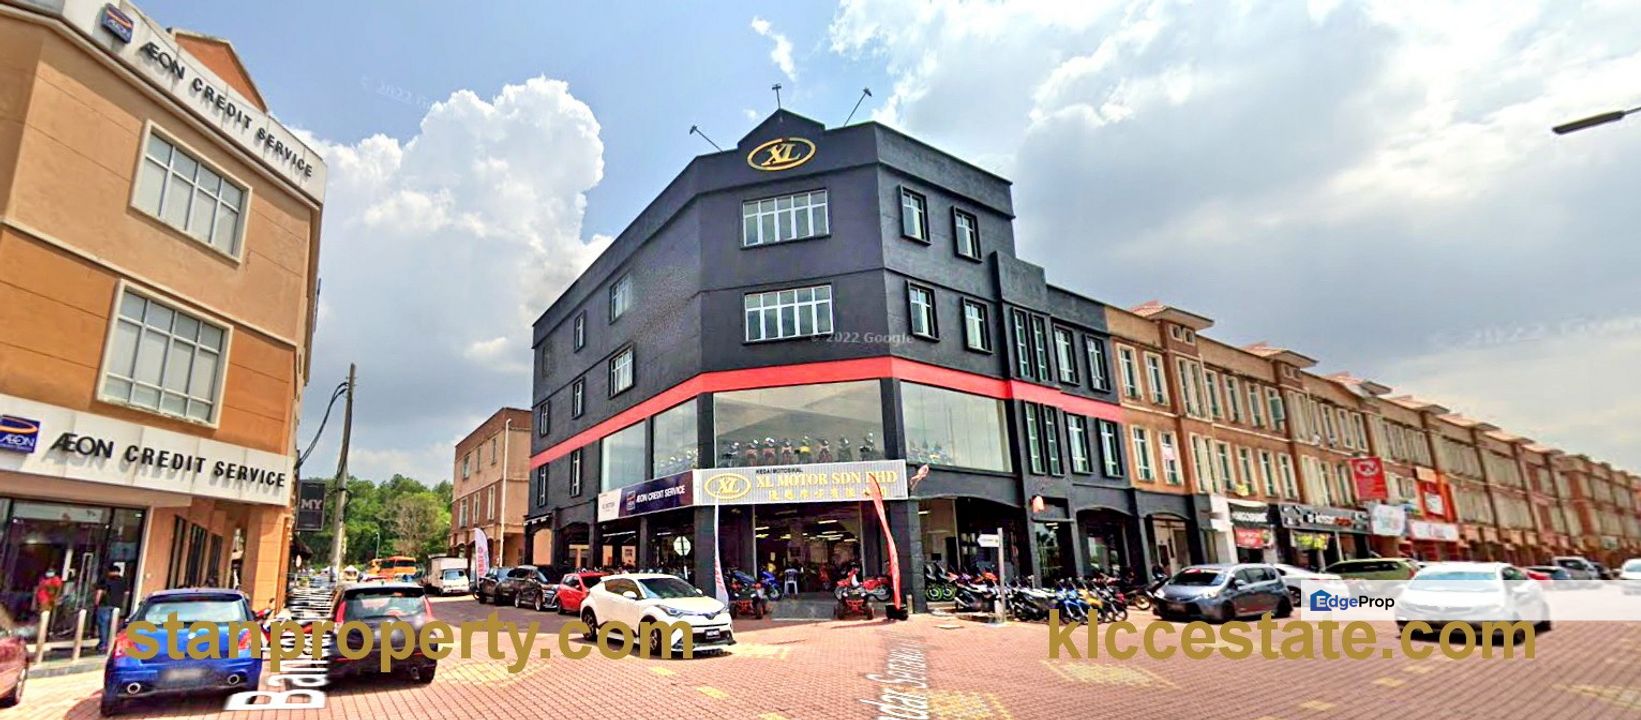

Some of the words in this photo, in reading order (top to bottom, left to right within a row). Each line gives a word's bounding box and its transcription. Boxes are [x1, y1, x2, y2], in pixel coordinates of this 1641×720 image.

[192, 77, 252, 129] CREDIT
[257, 127, 313, 178] SERVICE
[761, 143, 801, 167] XL
[124, 445, 206, 473] CREDIT
[214, 460, 286, 488] SERVICE
[717, 476, 741, 493] XL
[756, 474, 774, 488] XL
[776, 473, 828, 487] MOTOR
[831, 471, 862, 485] SDN
[648, 489, 665, 501] CREDIT
[665, 484, 686, 498] SERVICE
[301, 499, 322, 509] MY
